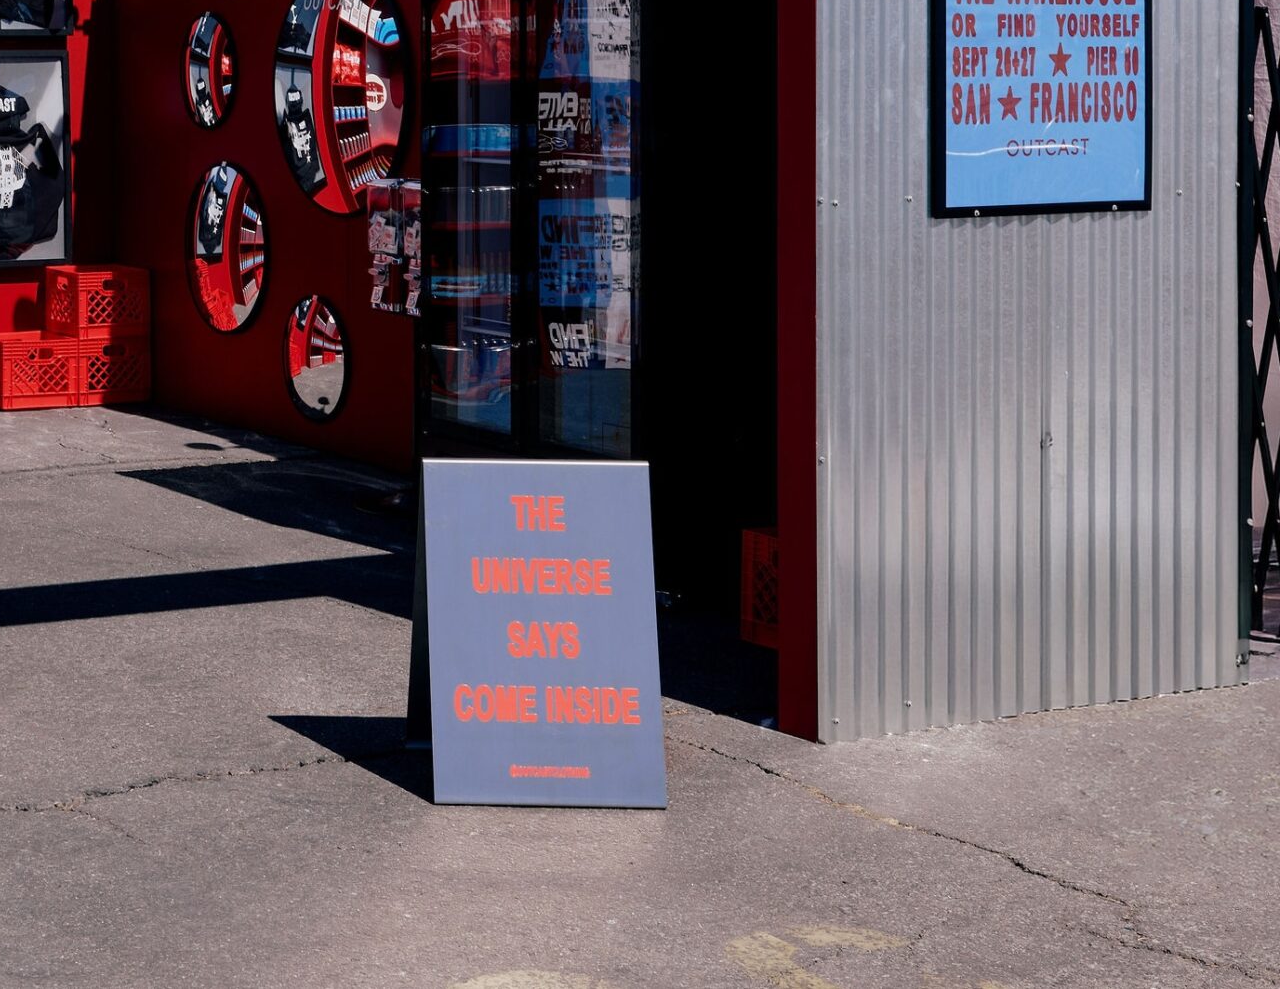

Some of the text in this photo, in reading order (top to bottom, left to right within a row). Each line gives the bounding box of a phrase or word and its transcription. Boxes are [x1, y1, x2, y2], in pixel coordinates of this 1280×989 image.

[951, 13, 1140, 37] OR FIND YOURSELF
[952, 46, 988, 77] SEPT
[1086, 46, 1117, 76] PIER
[1124, 46, 1139, 76] 80
[951, 80, 1137, 125] SAN FRANCISCO
[1006, 138, 1090, 157] OUTCAST
[509, 495, 566, 531] THE
[471, 556, 613, 595] UNIVERSE
[506, 619, 581, 659] SAYS
[453, 682, 641, 725] COME INSIDE
